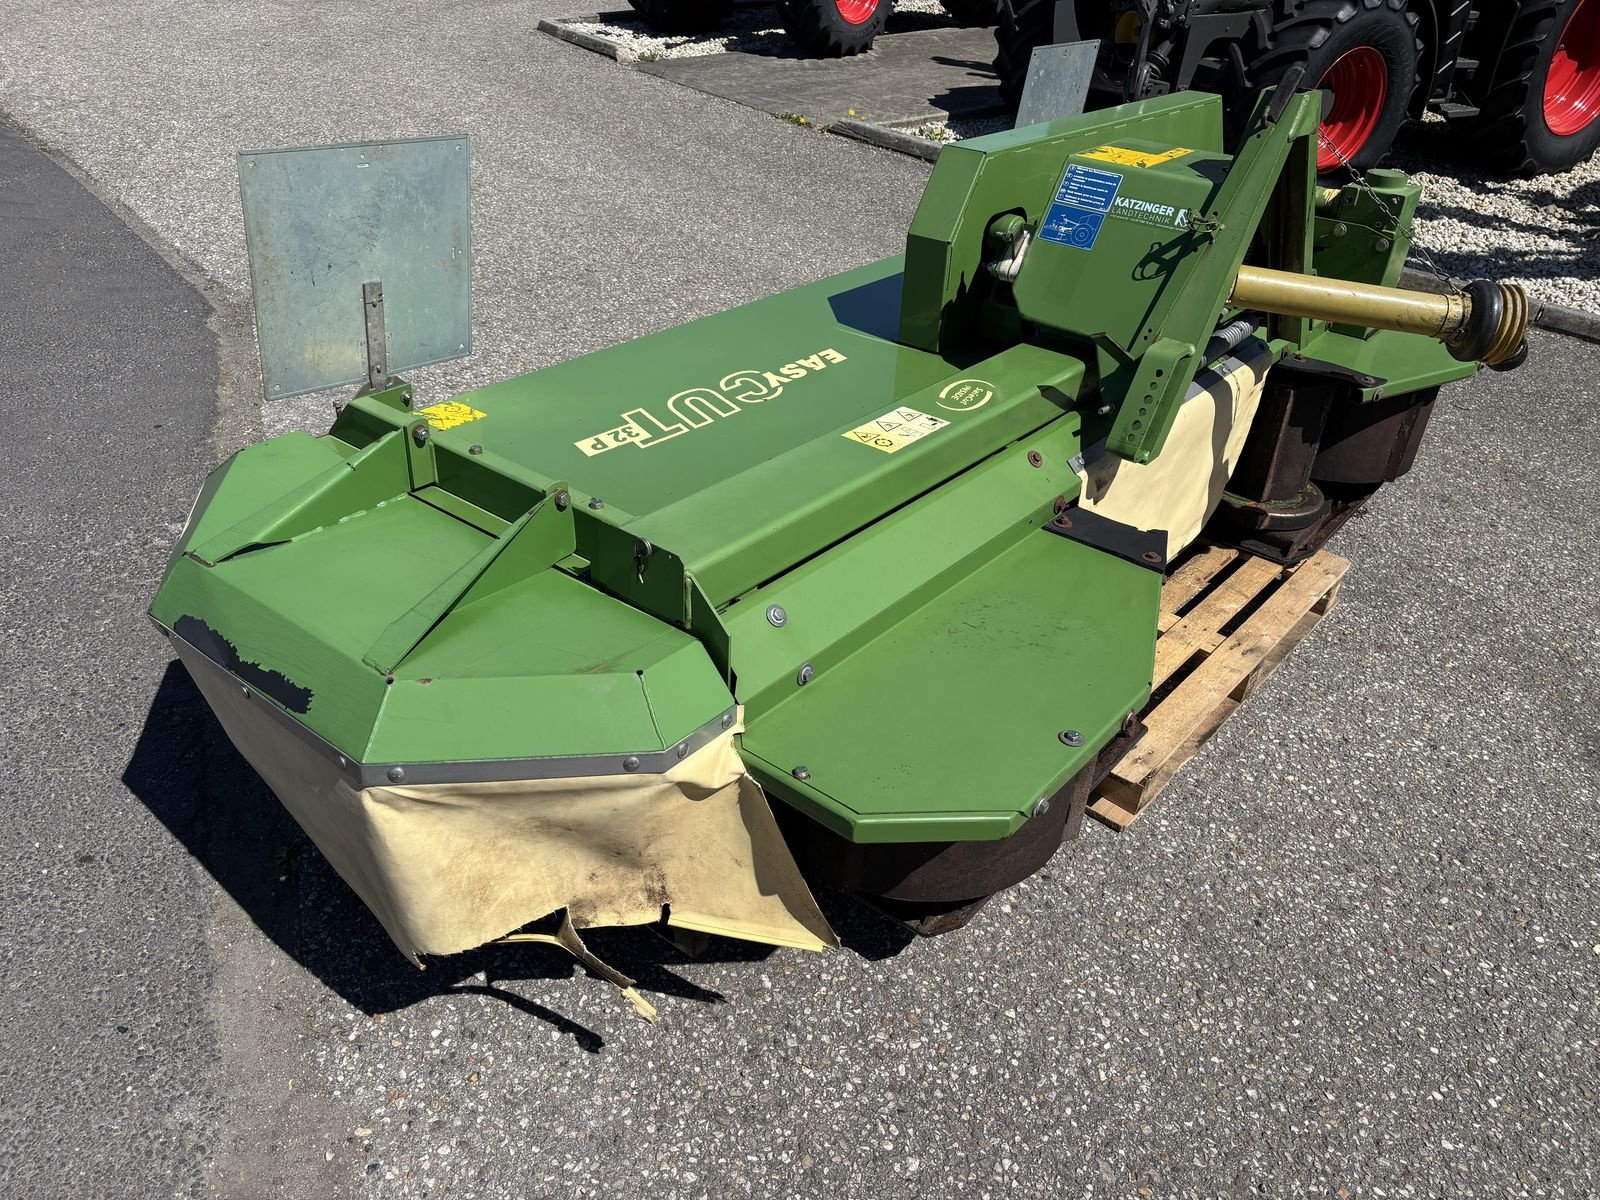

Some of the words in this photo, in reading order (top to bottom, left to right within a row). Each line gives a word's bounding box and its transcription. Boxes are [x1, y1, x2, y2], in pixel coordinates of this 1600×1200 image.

[1114, 196, 1175, 217] KATZINGER
[1111, 207, 1171, 224] LANDTECHNIK
[607, 425, 641, 443] 32
[590, 436, 609, 451] P
